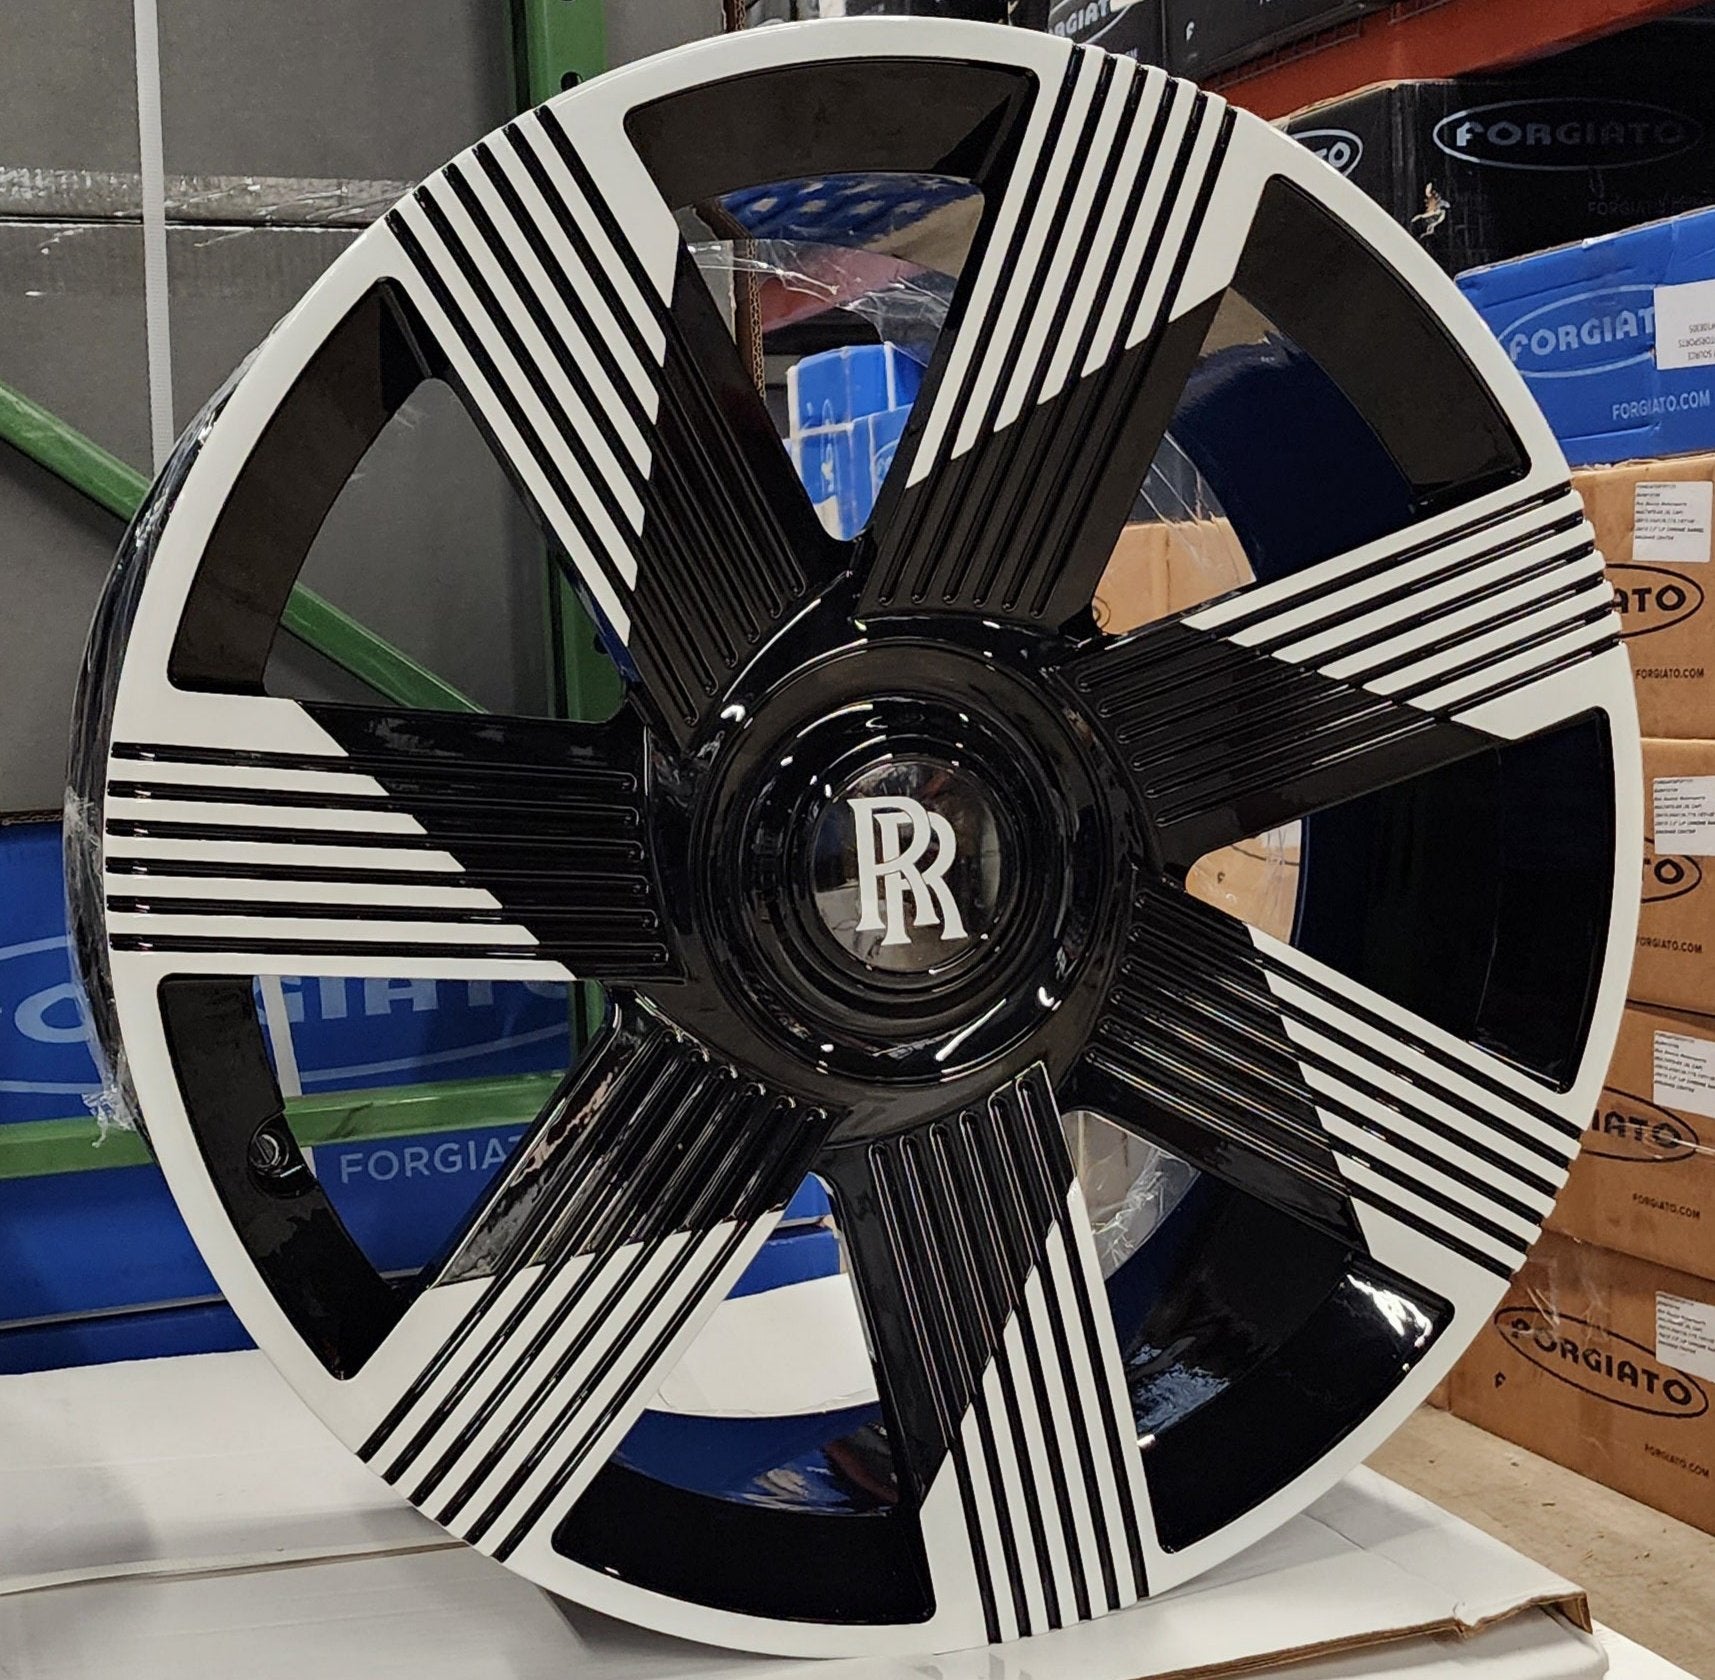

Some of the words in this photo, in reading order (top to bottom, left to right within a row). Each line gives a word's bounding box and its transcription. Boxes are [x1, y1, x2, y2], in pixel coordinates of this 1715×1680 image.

[1455, 120, 1682, 147] FORGIATO
[1509, 306, 1655, 362] FORGIAT
[1612, 389, 1711, 420] FORGIATO.COM
[1614, 584, 1686, 614] ATO
[1636, 667, 1704, 680] FORGIATO.COM
[847, 796, 968, 945] RR
[1592, 1108, 1682, 1149] IATO
[1633, 1193, 1700, 1219] FORGIATO.COM
[1511, 1317, 1693, 1406] FORGIATO
